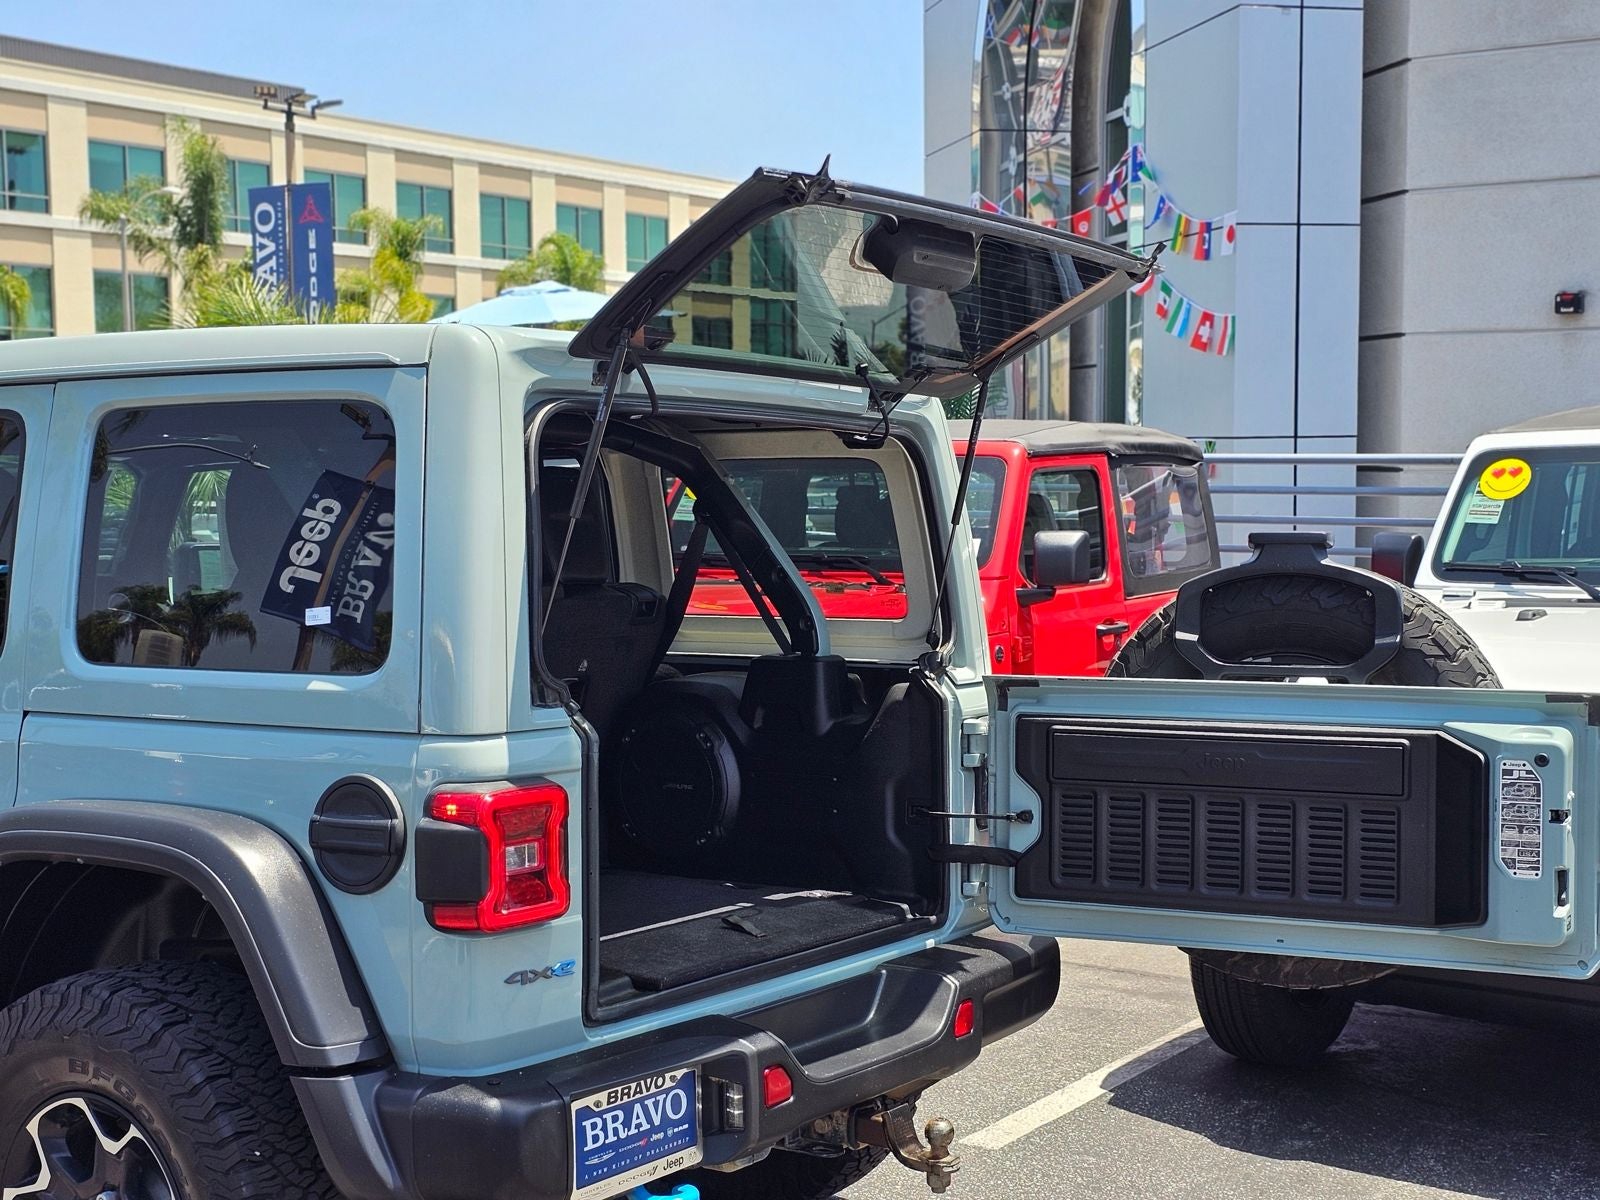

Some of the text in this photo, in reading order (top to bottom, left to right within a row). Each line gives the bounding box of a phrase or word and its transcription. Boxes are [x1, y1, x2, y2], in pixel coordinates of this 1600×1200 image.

[254, 202, 278, 300] AVO
[1503, 770, 1536, 779] JL
[606, 1075, 666, 1106] BRAVO
[582, 1088, 688, 1152] BRAVO
[650, 1131, 665, 1142] Jeep
[673, 1123, 689, 1132] RAM
[593, 1168, 608, 1176] NEW
[612, 1158, 630, 1169] KIND
[634, 1153, 643, 1161] OF
[646, 1136, 690, 1157] DEALERSHIP
[663, 1155, 684, 1171] Jeep
